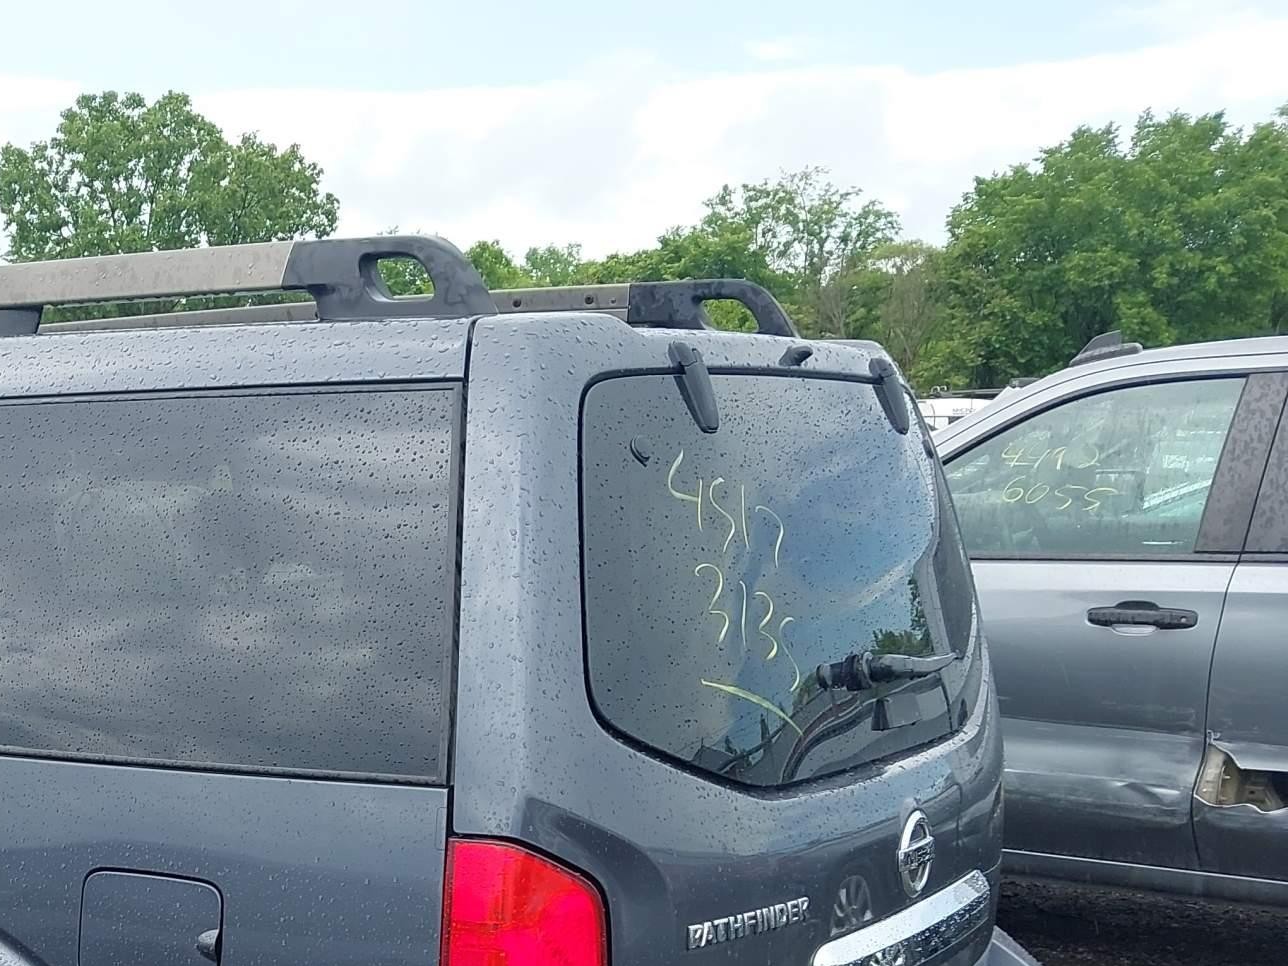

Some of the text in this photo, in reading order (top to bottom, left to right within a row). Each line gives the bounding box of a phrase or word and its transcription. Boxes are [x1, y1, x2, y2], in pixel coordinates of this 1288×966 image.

[667, 448, 785, 569] 4517
[1002, 474, 1120, 513] 6055
[693, 562, 801, 692] 3135
[687, 896, 810, 950] PATHFINDER
